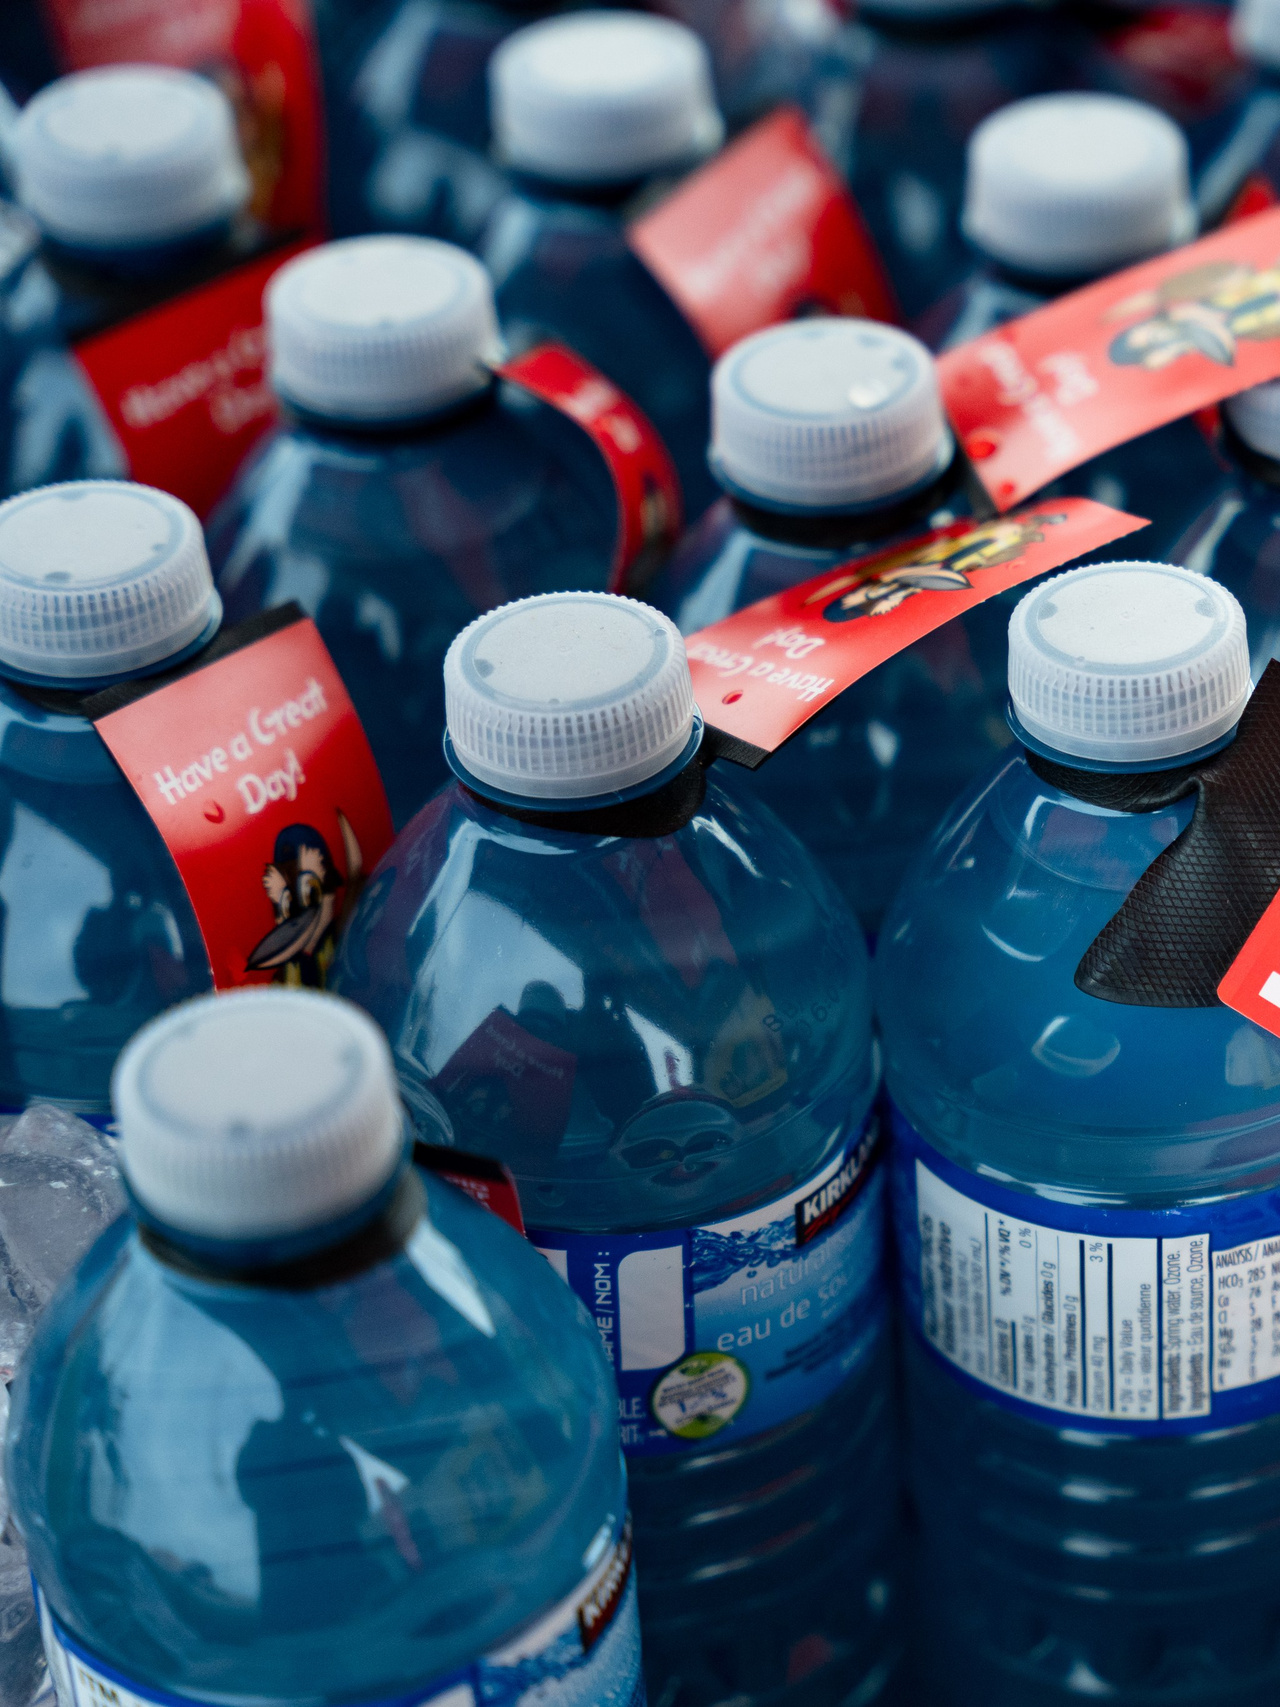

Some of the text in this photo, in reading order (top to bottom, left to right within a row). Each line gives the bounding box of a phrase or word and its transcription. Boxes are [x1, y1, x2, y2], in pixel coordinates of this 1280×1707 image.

[748, 662, 775, 677] a
[766, 668, 834, 702] Have
[154, 677, 328, 804] Have a Great
[236, 748, 306, 814] Day!
[1163, 1250, 1181, 1285] Ozone.
[1186, 1238, 1204, 1273] Ozone.
[1216, 1248, 1252, 1269] ANALYSIS
[594, 1263, 612, 1304] NOM
[1248, 1265, 1266, 1283] 285
[1041, 1280, 1055, 1325] Glucides
[1168, 1287, 1183, 1316] water,
[1189, 1274, 1206, 1310] source,
[716, 1318, 773, 1353] eau
[779, 1296, 811, 1329] de
[1137, 1284, 1153, 1342] quotidienne
[1187, 1312, 1203, 1324] de
[1119, 1319, 1132, 1349] Value
[1165, 1318, 1183, 1351] Spring
[1187, 1327, 1204, 1346] Eau
